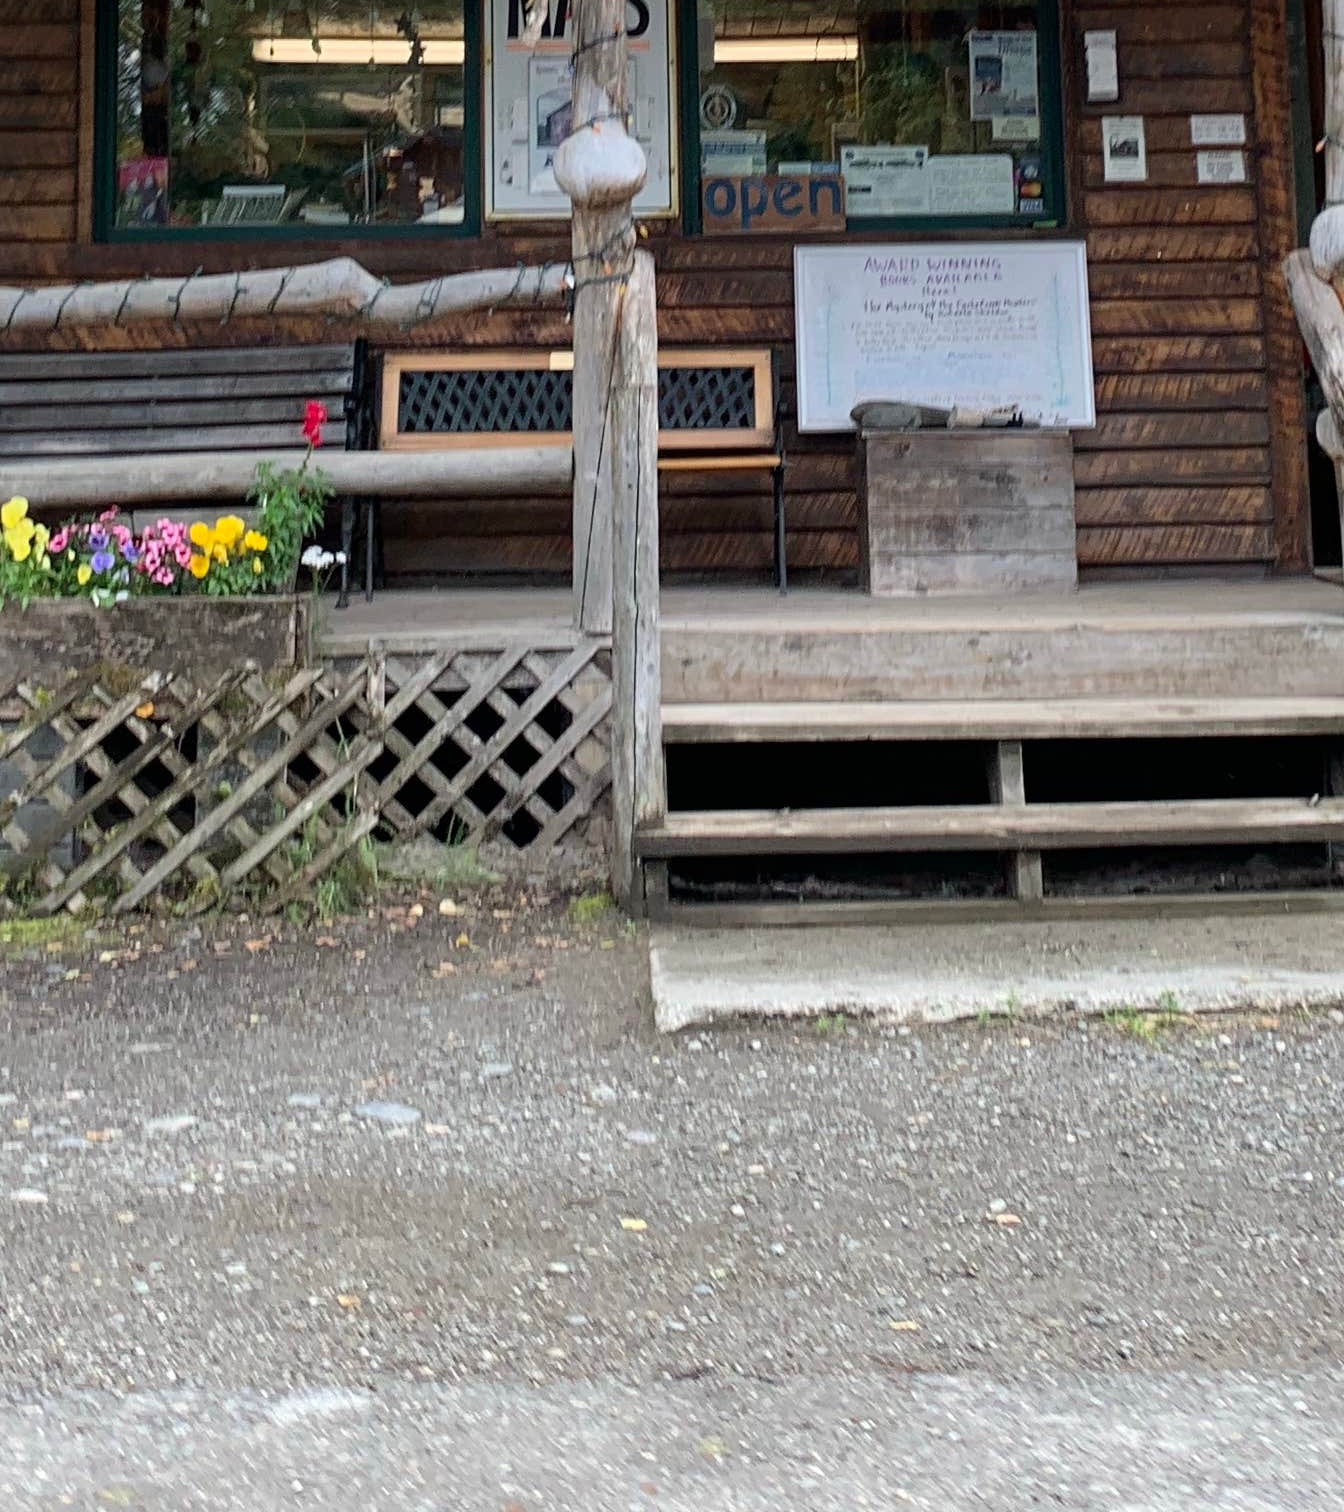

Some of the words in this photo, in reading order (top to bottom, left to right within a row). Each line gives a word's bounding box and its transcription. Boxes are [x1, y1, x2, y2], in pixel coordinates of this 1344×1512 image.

[706, 178, 842, 232] open
[864, 255, 920, 272] AWARD
[927, 255, 1002, 271] WINNING
